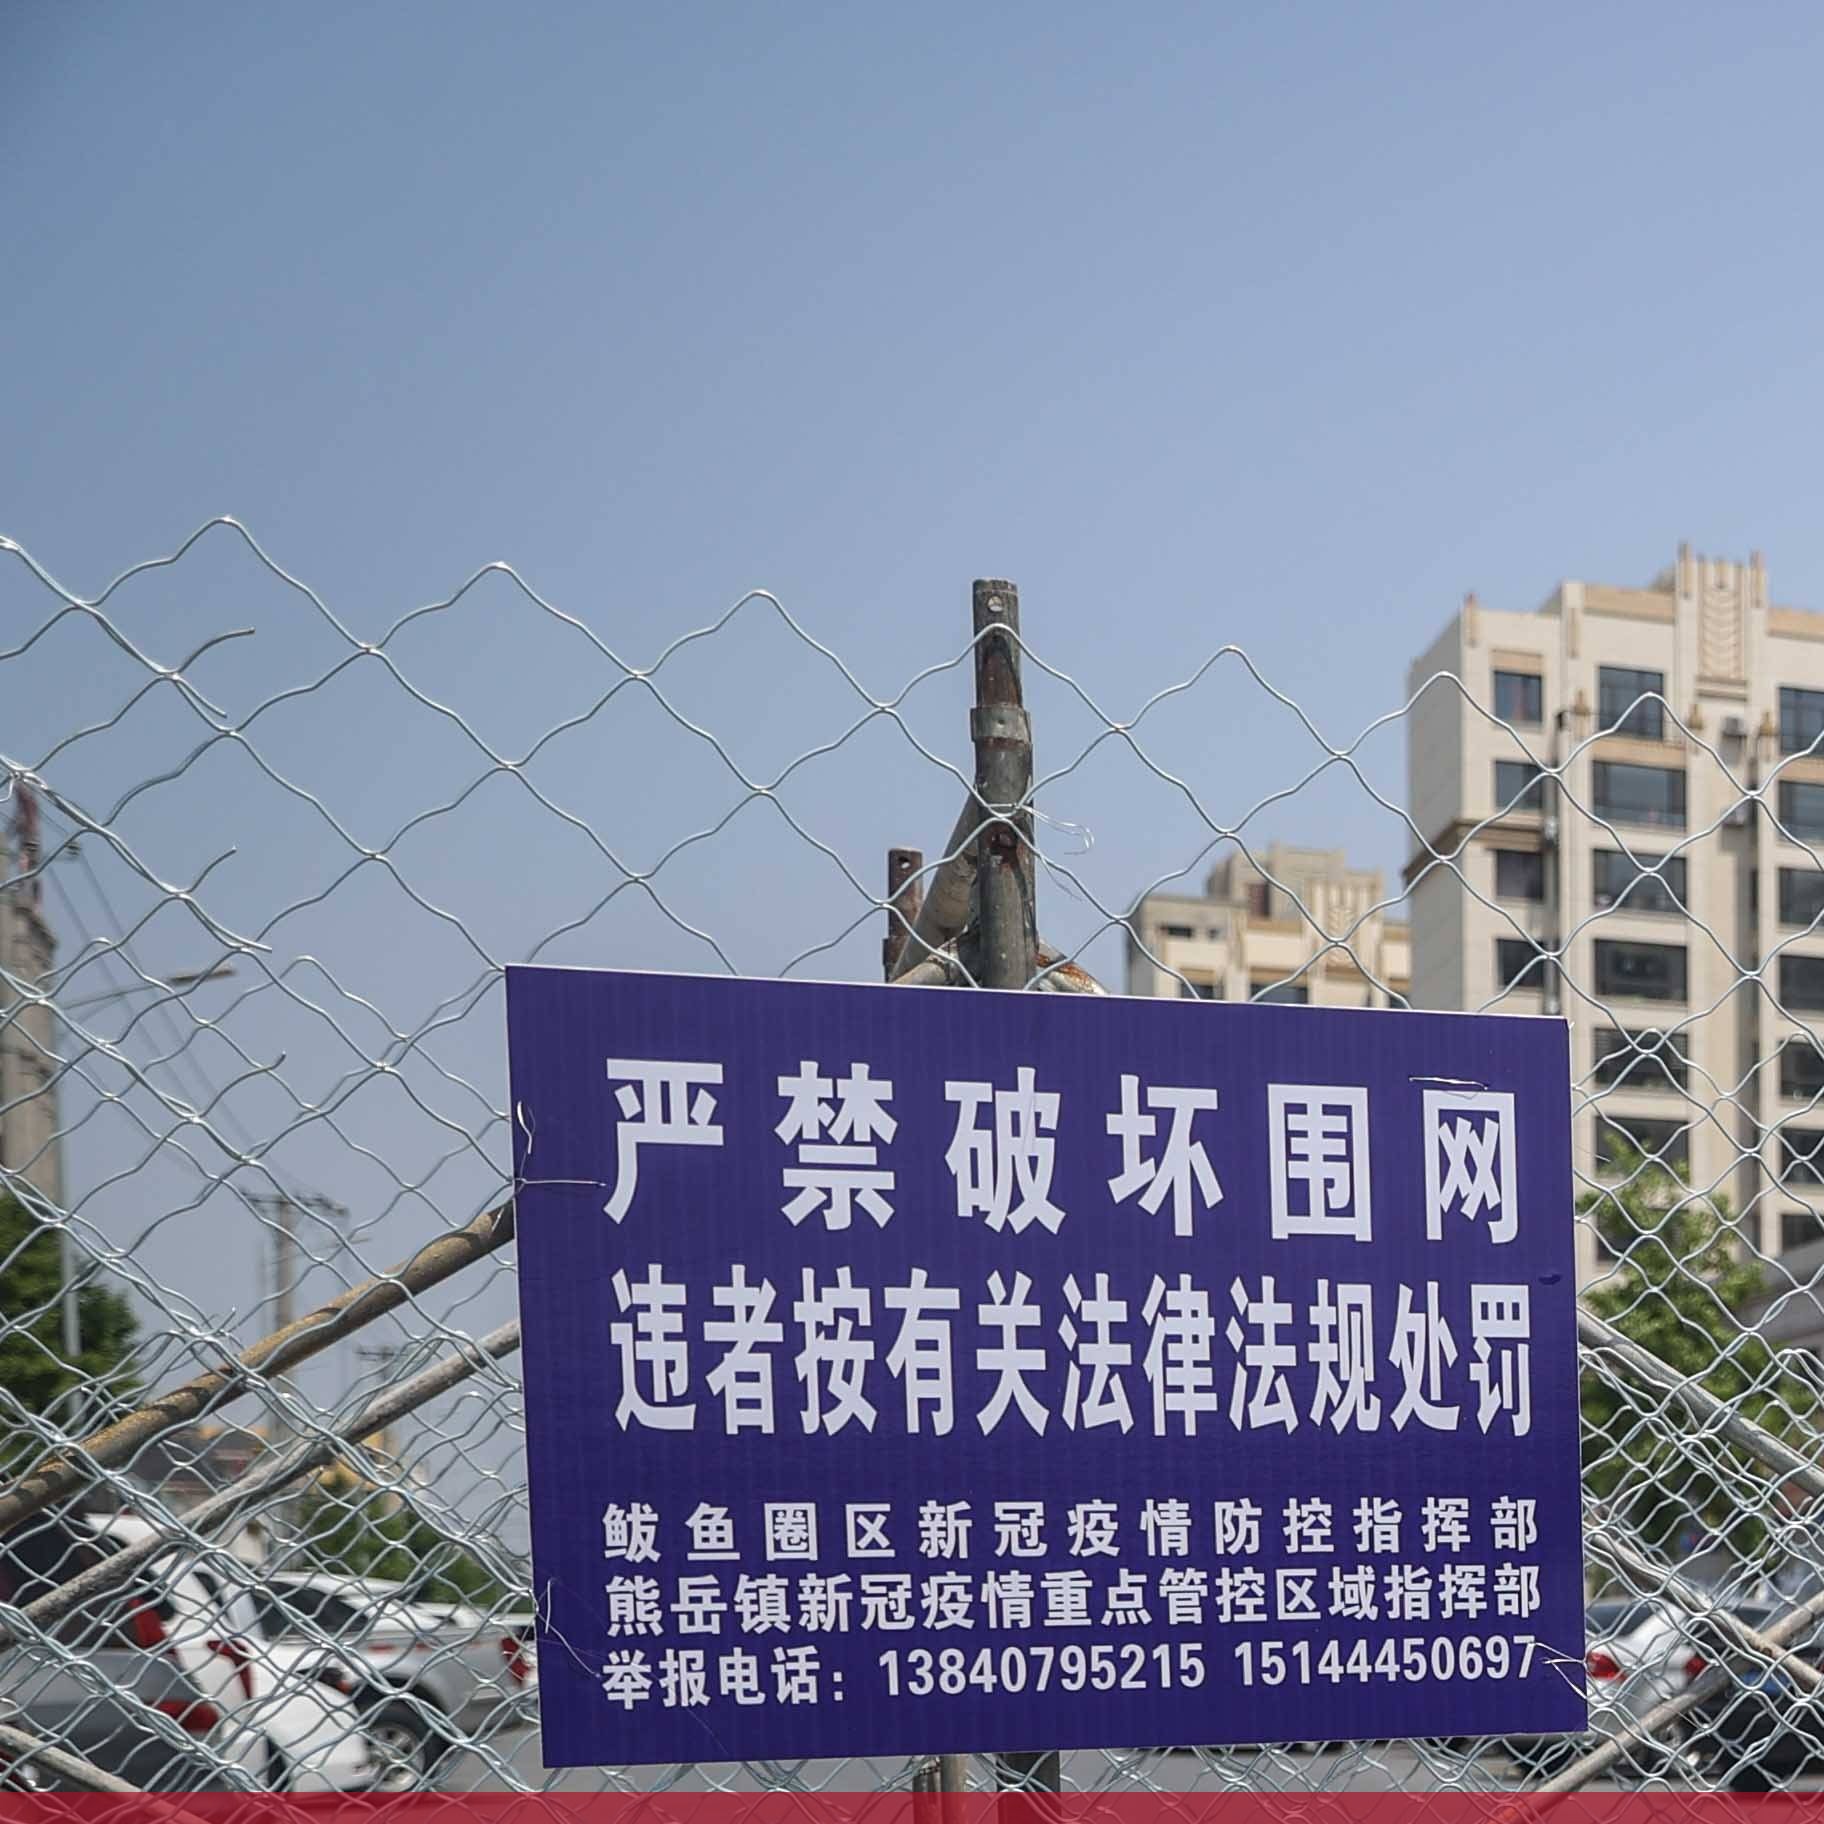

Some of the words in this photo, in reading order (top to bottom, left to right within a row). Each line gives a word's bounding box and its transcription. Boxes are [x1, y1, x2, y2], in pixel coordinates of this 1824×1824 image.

[602, 1058, 1520, 1244] 严禁破坏围网
[610, 1262, 1533, 1437] 违者按有关法律法规处罚
[601, 1496, 1539, 1565] 鲅鱼圈区新冠疫情防控指挥部
[605, 1561, 1541, 1637] 熊岳镇新冠疫情重点管控区域指挥部
[878, 1643, 1205, 1698] 13840795215
[1233, 1635, 1538, 1688] 15144450697
